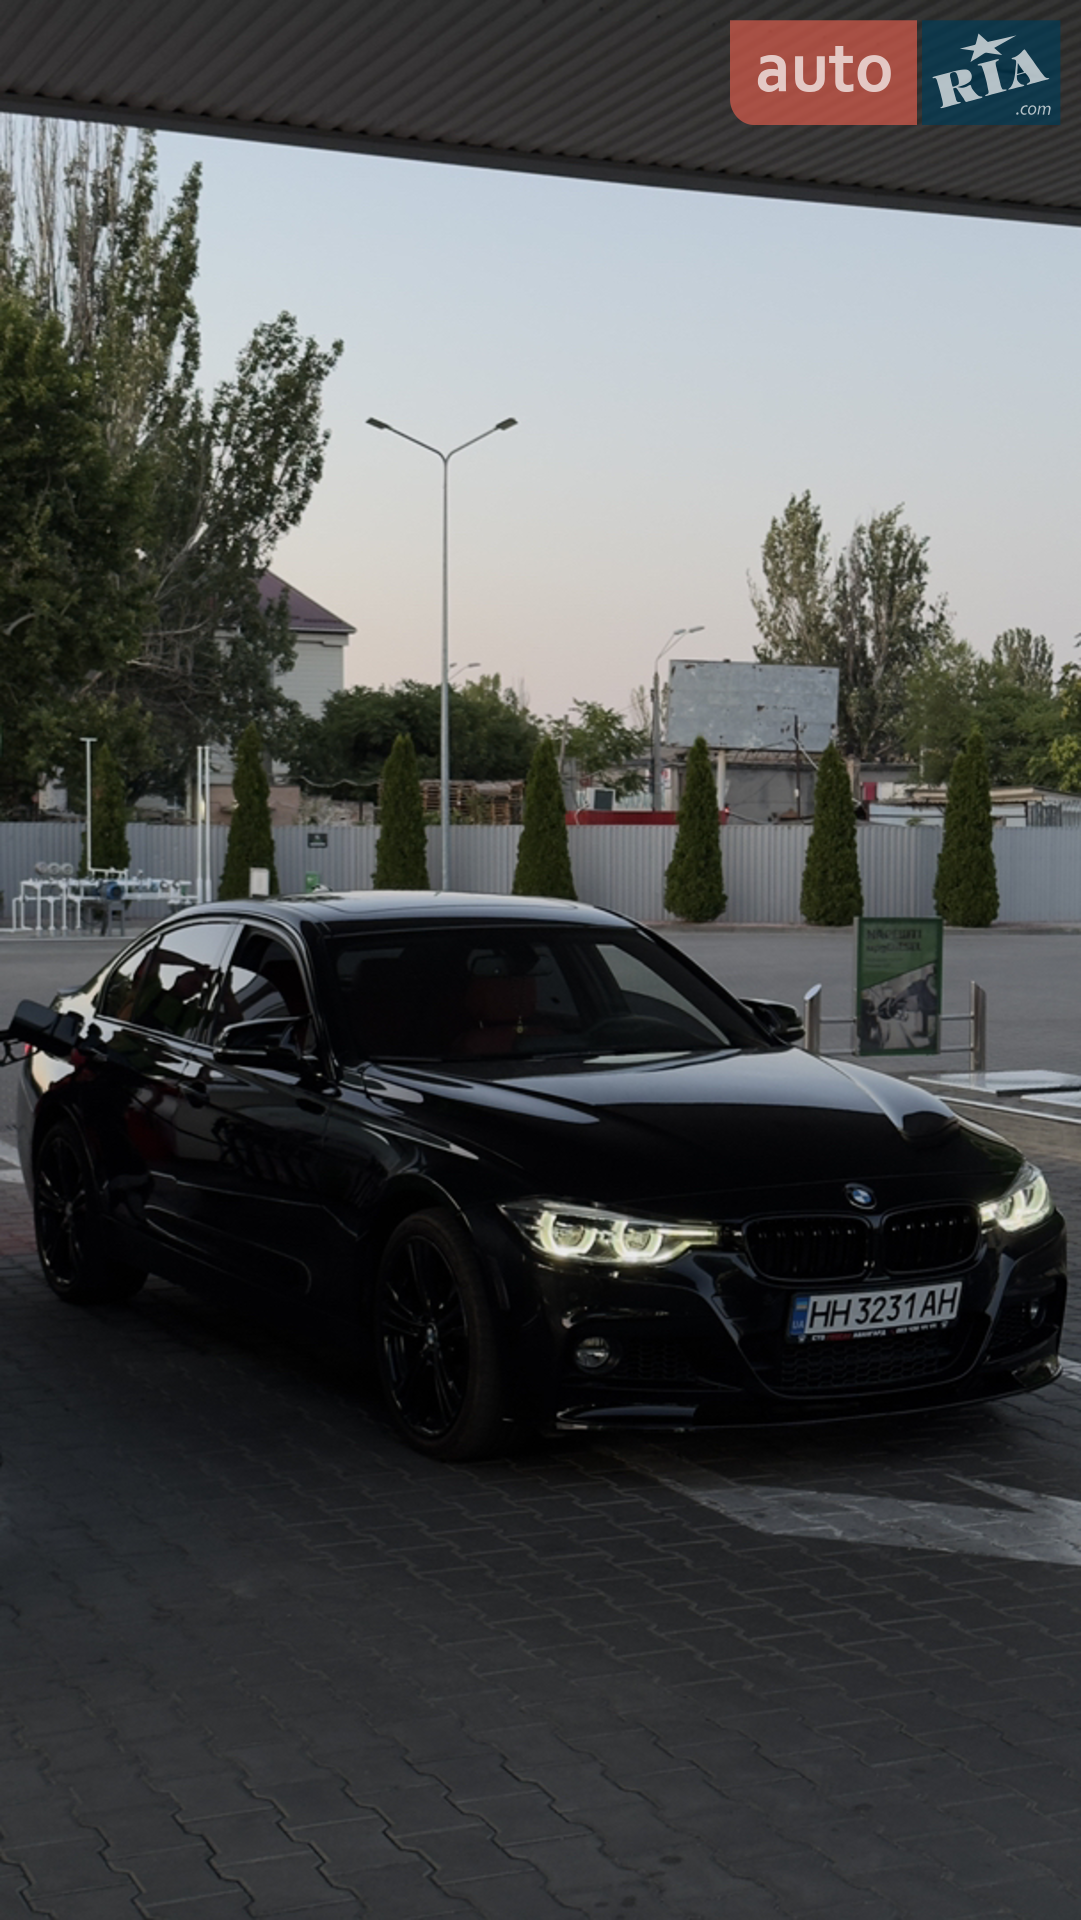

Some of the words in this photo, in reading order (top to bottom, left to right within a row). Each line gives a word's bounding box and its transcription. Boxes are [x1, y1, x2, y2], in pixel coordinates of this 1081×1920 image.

[809, 1299, 852, 1329] HH
[855, 1291, 917, 1325] 3231
[919, 1286, 958, 1318] AH
